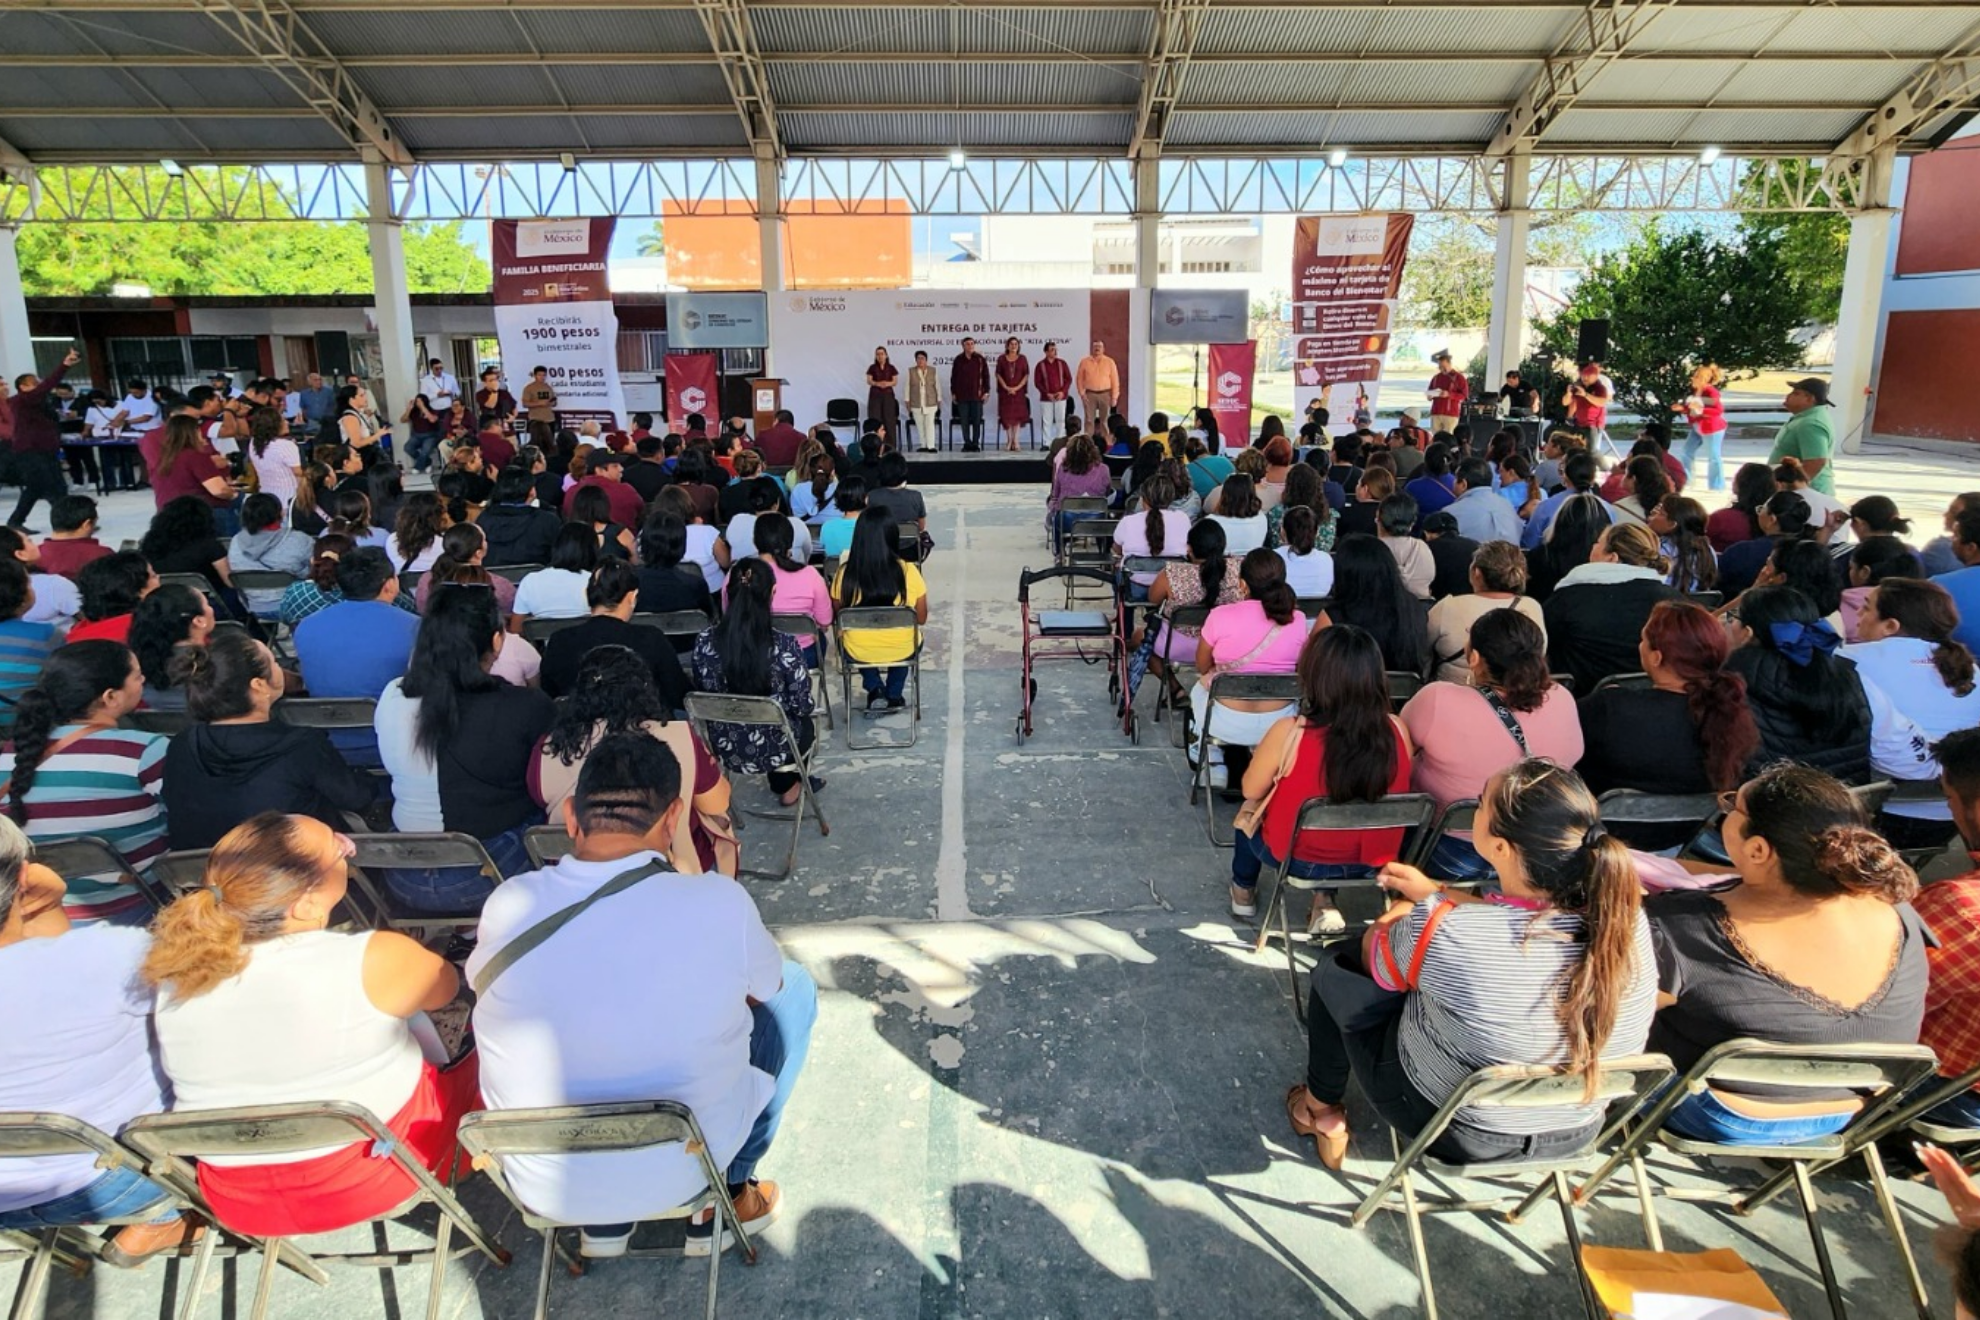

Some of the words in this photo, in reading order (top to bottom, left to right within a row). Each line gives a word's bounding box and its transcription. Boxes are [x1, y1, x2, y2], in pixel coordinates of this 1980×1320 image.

[544, 233, 583, 243] México
[502, 265, 540, 275] FAMILIA
[541, 262, 606, 273] BENEFICIARIA
[1302, 276, 1337, 285] máximo
[522, 288, 539, 296] 2025
[1305, 288, 1331, 296] Banco
[809, 302, 846, 311] México
[537, 317, 582, 325] Recibirás
[921, 324, 970, 333] ENTREGA
[973, 323, 986, 332] DE
[989, 323, 1038, 334] TARJETAS
[522, 327, 557, 340] 1900
[561, 327, 600, 340] pesos
[537, 343, 592, 352] bimestrales
[569, 368, 604, 380] pesos
